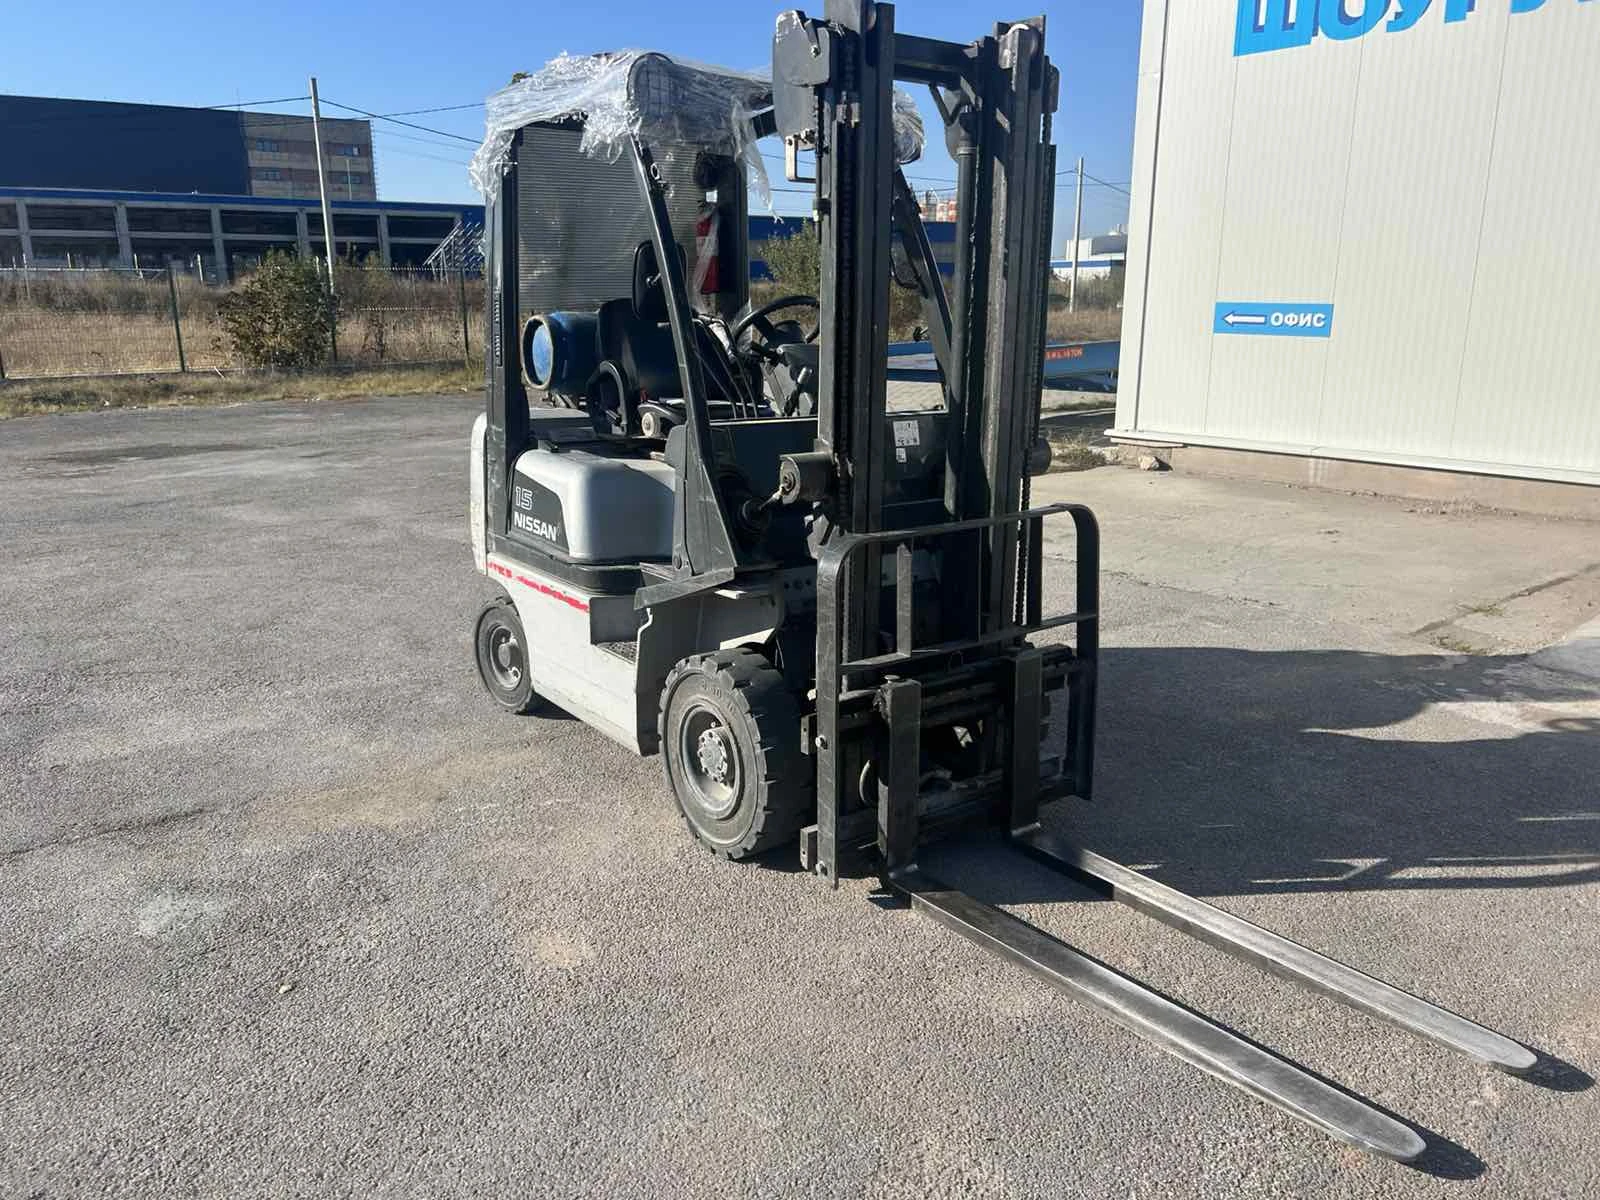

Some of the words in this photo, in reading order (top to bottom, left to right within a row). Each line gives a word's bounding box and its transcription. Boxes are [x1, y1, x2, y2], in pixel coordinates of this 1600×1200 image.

[1270, 312, 1326, 328] ОФИС
[515, 486, 533, 510] 15
[513, 511, 557, 542] NISSAN
